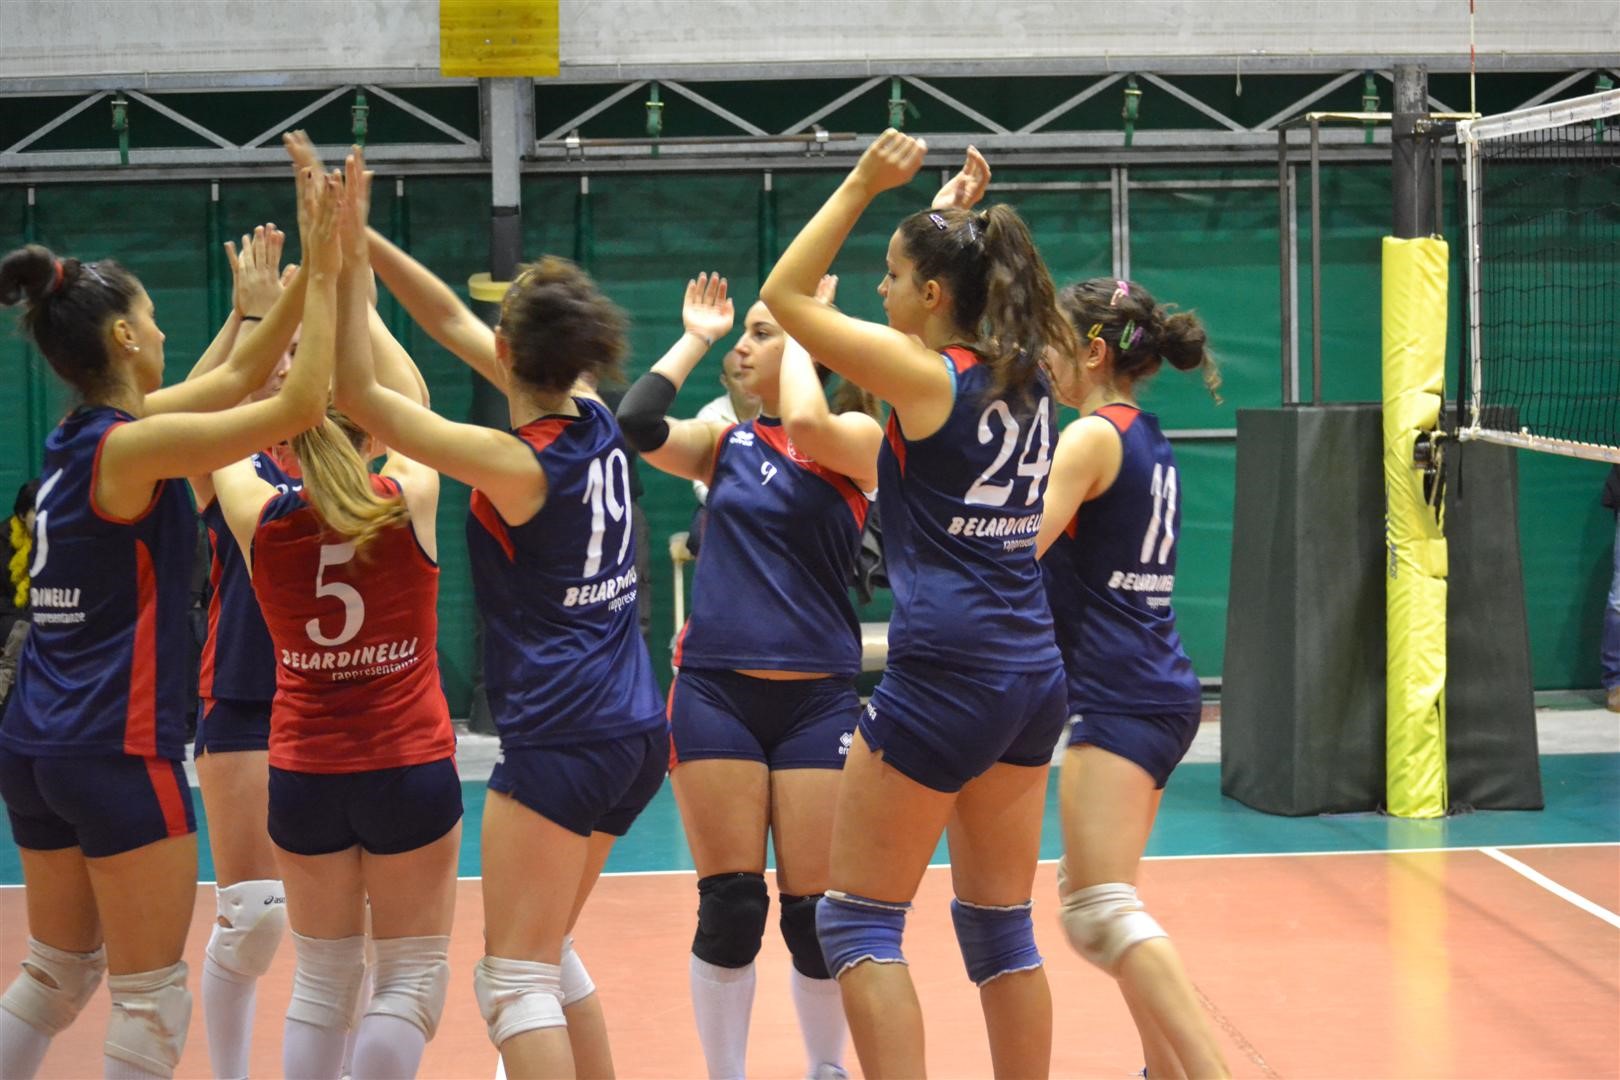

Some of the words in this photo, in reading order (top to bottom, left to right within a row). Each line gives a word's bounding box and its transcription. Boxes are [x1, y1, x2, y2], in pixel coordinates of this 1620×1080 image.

[760, 461, 777, 486] 9
[964, 396, 1051, 507] 24
[582, 448, 632, 578] 19
[1140, 462, 1177, 564] 11
[305, 541, 365, 646] 5
[281, 636, 418, 670] BELARDINELLI
